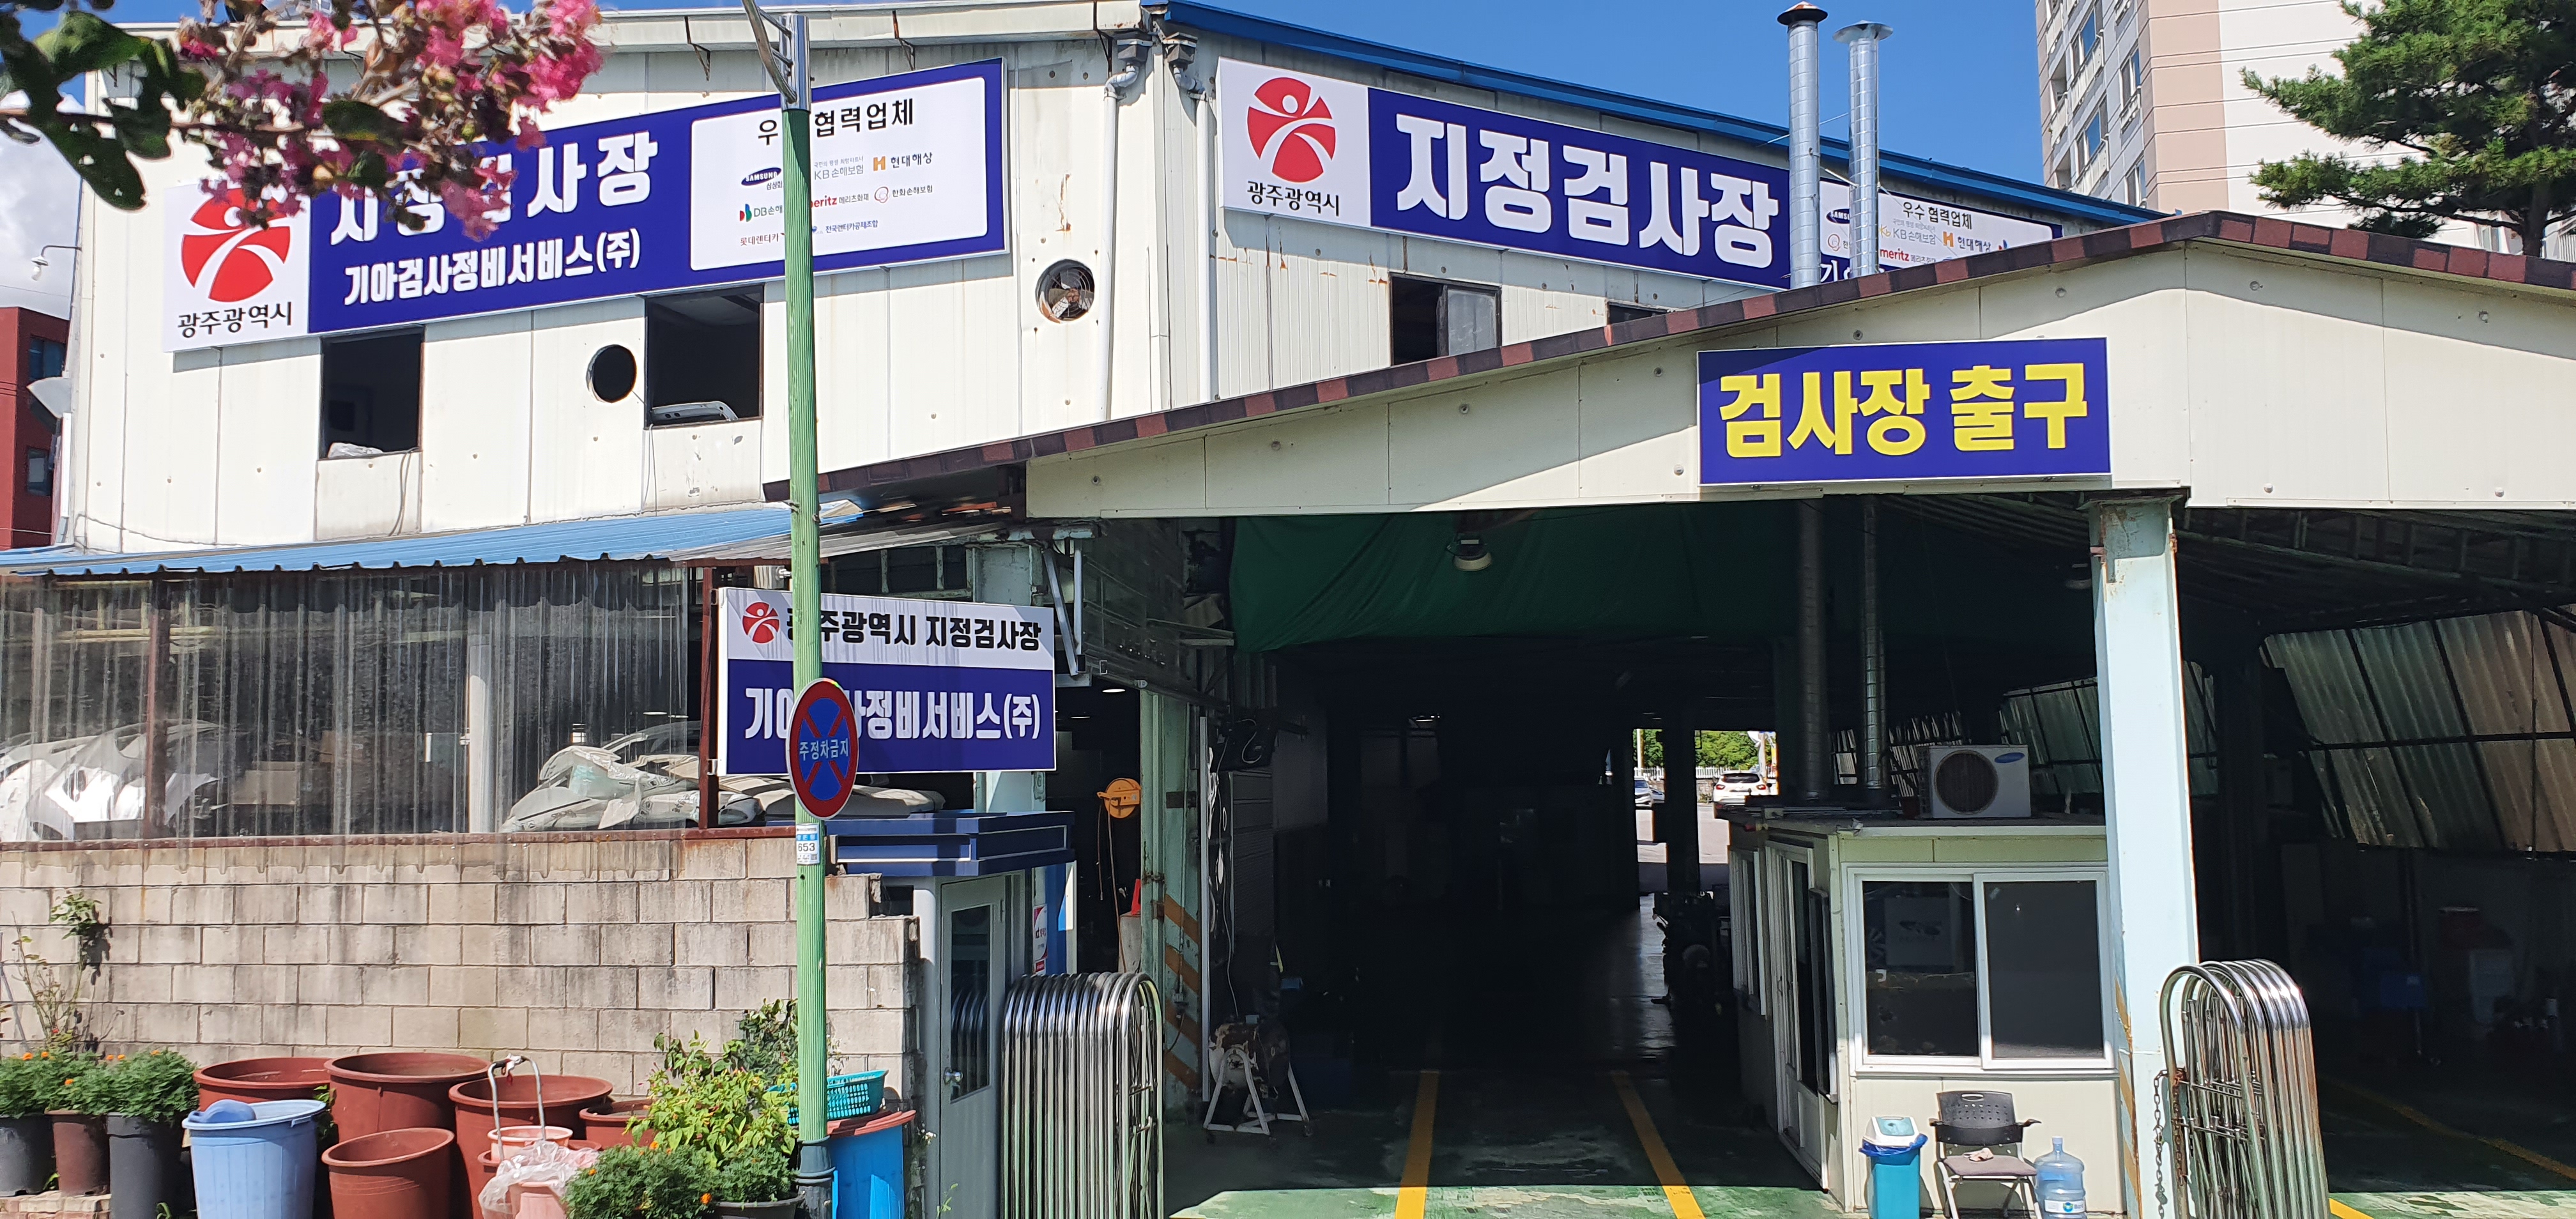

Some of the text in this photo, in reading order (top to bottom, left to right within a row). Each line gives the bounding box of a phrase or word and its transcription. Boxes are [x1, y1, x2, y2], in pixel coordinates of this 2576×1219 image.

[815, 98, 914, 137] 협력업체
[891, 152, 933, 168] 현대해상
[746, 171, 778, 182] SAMSUNG
[839, 193, 869, 204] 메리츠화재
[892, 185, 933, 197] 한화손해보험
[1246, 180, 1340, 217] 광주광역시
[1397, 113, 1779, 269] 지정검사장
[1903, 201, 1925, 220] 우수
[1928, 206, 1972, 230] 협력업체
[740, 233, 779, 246] 롯데렌터카
[1958, 236, 1991, 252] 현대해상
[344, 227, 640, 305] 기아검사정비서비스(주)
[1879, 248, 1910, 261] meritz
[177, 301, 292, 339] 광주광역시
[1719, 362, 2088, 458] 검사장 출구
[926, 615, 1043, 651] 지정검사장
[799, 737, 849, 762] 주정차금지
[798, 842, 815, 852] 653
